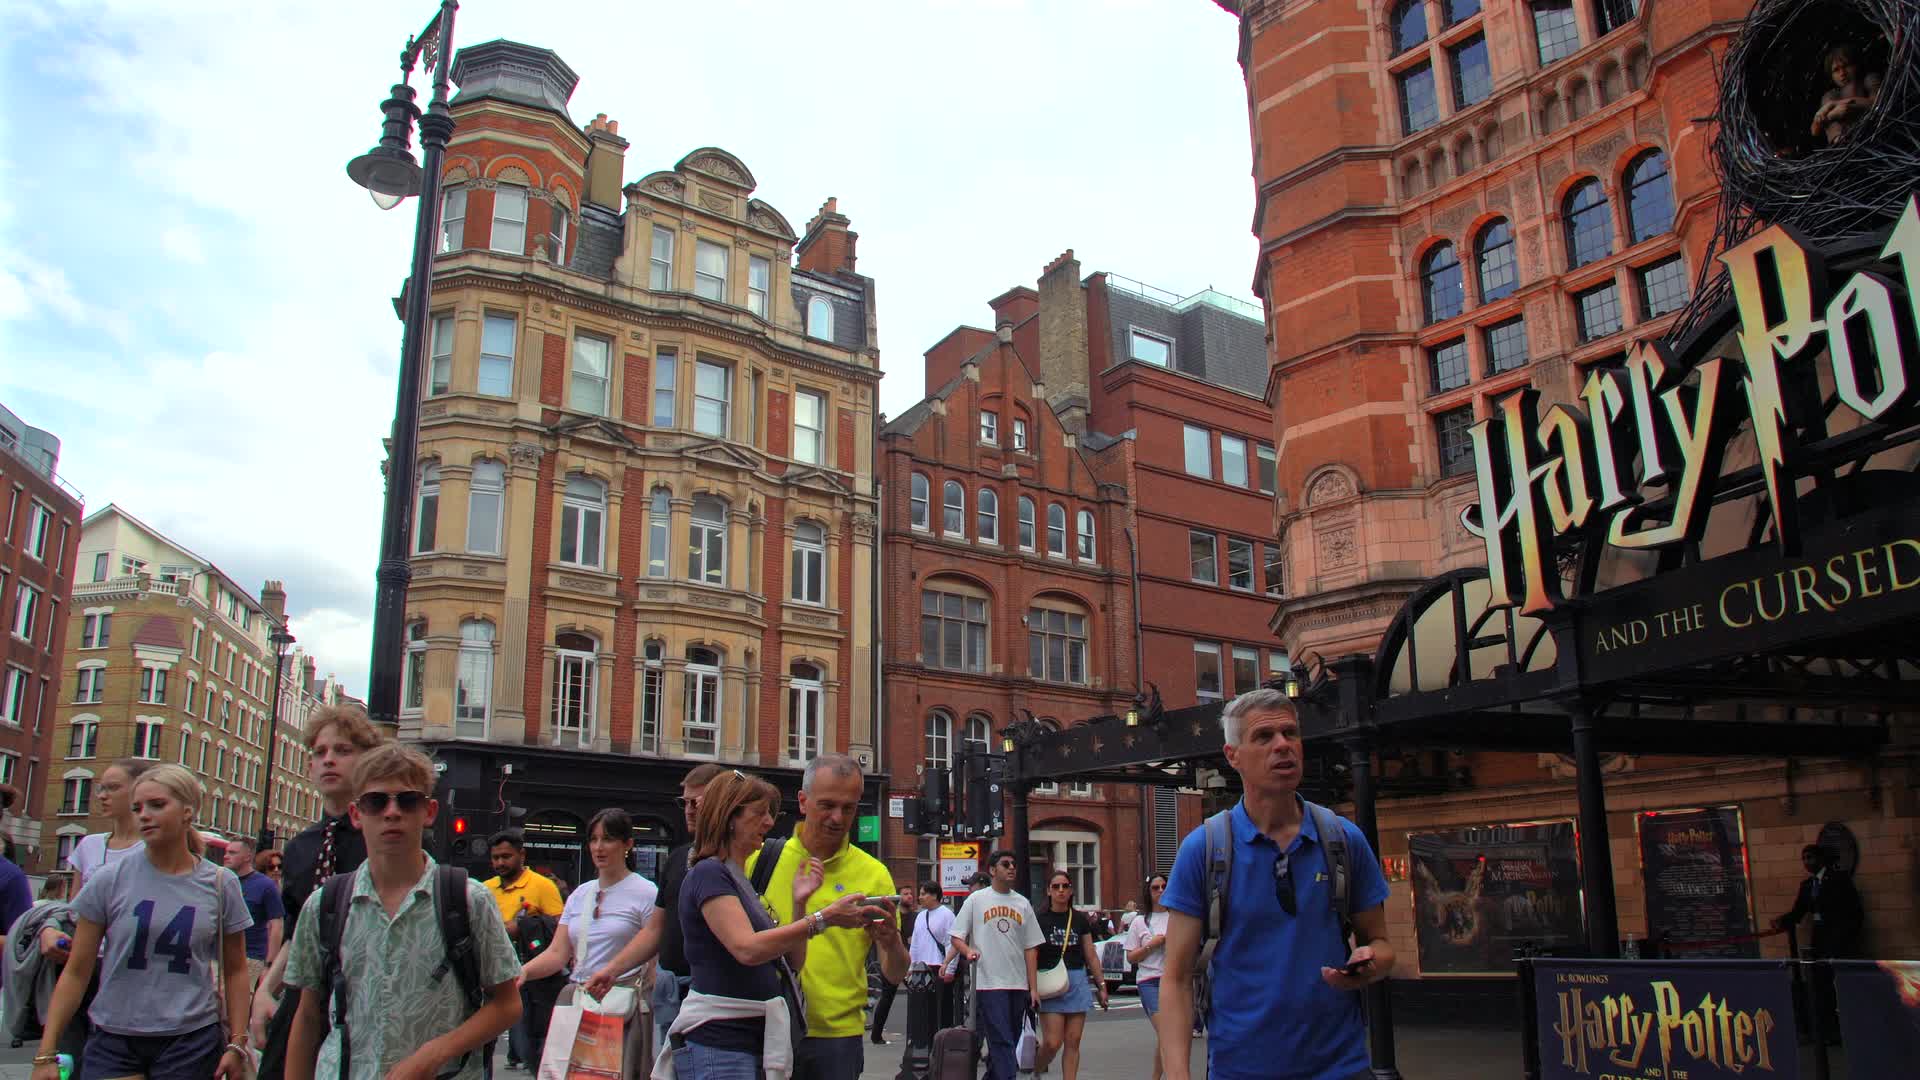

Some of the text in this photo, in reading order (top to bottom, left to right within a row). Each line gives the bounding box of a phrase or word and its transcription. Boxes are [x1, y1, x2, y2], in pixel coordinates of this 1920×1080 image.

[1460, 338, 1722, 617] Harry
[1596, 538, 1920, 656] AND THE CURSED
[127, 899, 196, 975] 14
[983, 905, 1023, 926] ADIDAS
[1553, 980, 1776, 1080] Harry Potter
[1643, 1067, 1662, 1078] AND
[1671, 1069, 1689, 1080] THE
